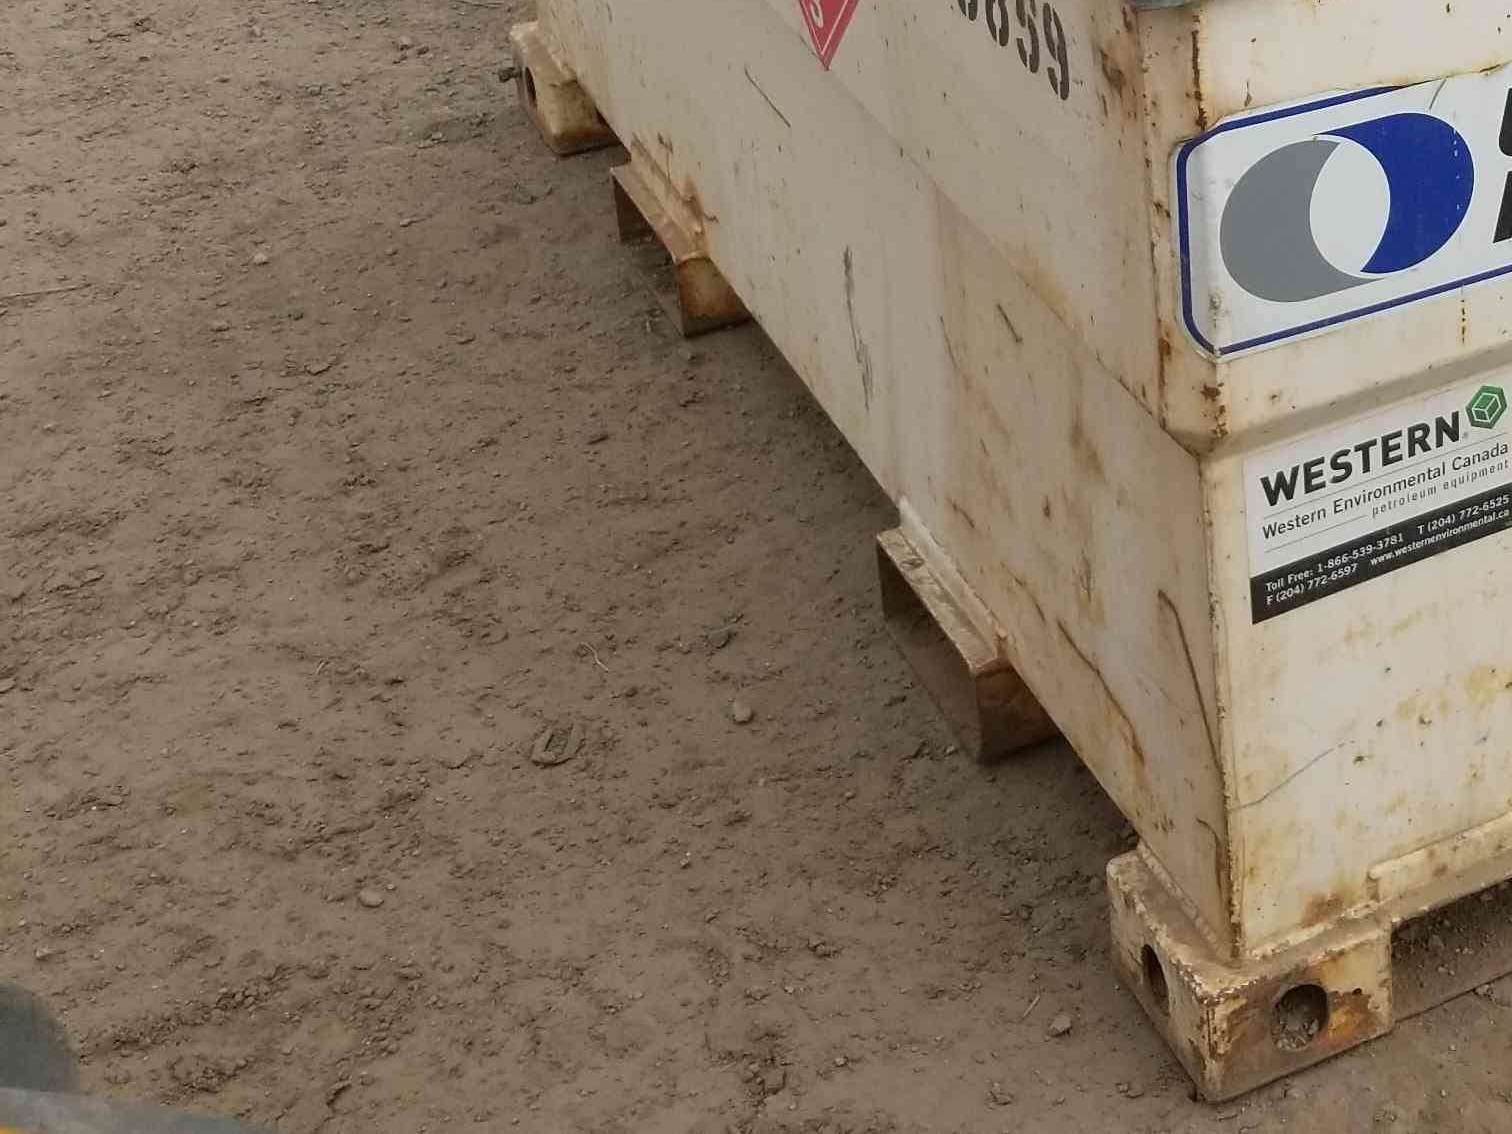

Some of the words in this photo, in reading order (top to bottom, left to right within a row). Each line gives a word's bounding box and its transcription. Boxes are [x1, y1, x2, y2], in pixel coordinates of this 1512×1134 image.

[1260, 410, 1461, 507] WESTERN
[1262, 507, 1327, 539] Western
[1333, 462, 1446, 514] Environmental
[1452, 441, 1509, 471] Canada
[1371, 487, 1437, 519] petroleum
[1443, 459, 1509, 492] equipment
[1266, 577, 1284, 592] Toll
[1287, 569, 1313, 585] Free:
[1417, 524, 1425, 535] T
[1427, 514, 1456, 533] (204)
[1266, 594, 1274, 606] F
[1276, 583, 1304, 603] (204)
[1370, 508, 1510, 566] www.westernenvironmental.ca
